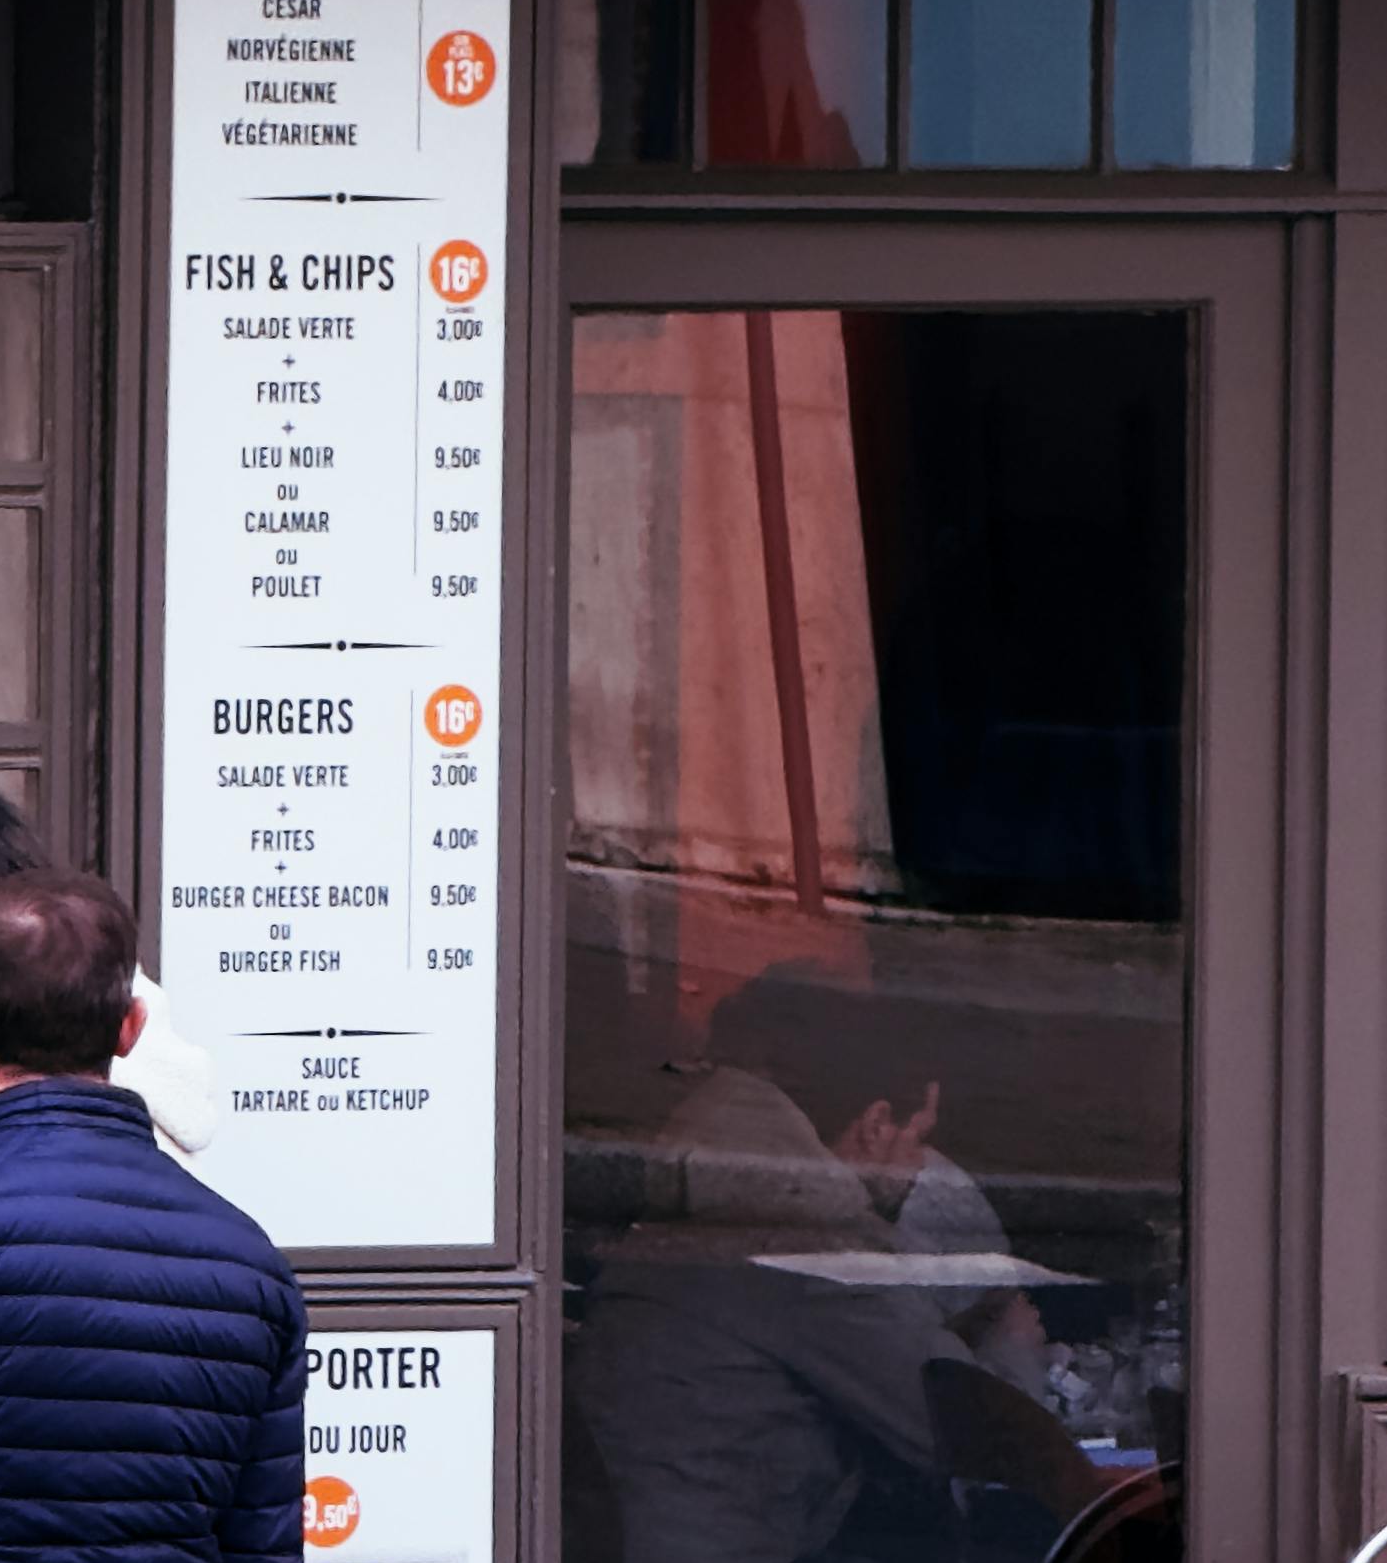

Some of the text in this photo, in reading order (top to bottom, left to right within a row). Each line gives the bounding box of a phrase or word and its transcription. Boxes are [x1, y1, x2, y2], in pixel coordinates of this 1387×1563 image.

[226, 34, 356, 62] NORVÉGIENNE
[443, 59, 484, 95] 13€
[244, 81, 337, 105] ITALIENNE
[222, 118, 358, 146] VÉGÉTARIENNE
[185, 254, 395, 292] FISH & CHIPS
[438, 256, 481, 292] 16€
[224, 317, 355, 339] SALADE VERTE
[256, 382, 321, 404] FRITES
[241, 446, 334, 468] LIEU NOIR
[244, 511, 330, 533] CALAMAR
[251, 576, 322, 598] POULET
[214, 698, 354, 736] BURGERS
[218, 765, 349, 788] SALADE VERTE
[250, 829, 315, 852] FRITES
[172, 886, 389, 908] BURGER CHEESE BACON
[219, 951, 340, 973] BURGER FISH
[302, 1057, 361, 1079] SAUCE
[232, 1090, 310, 1113] TARTARE
[346, 1089, 431, 1111] KETCHUP
[304, 1348, 441, 1390] PORTER
[309, 1425, 406, 1454] DU JOUR
